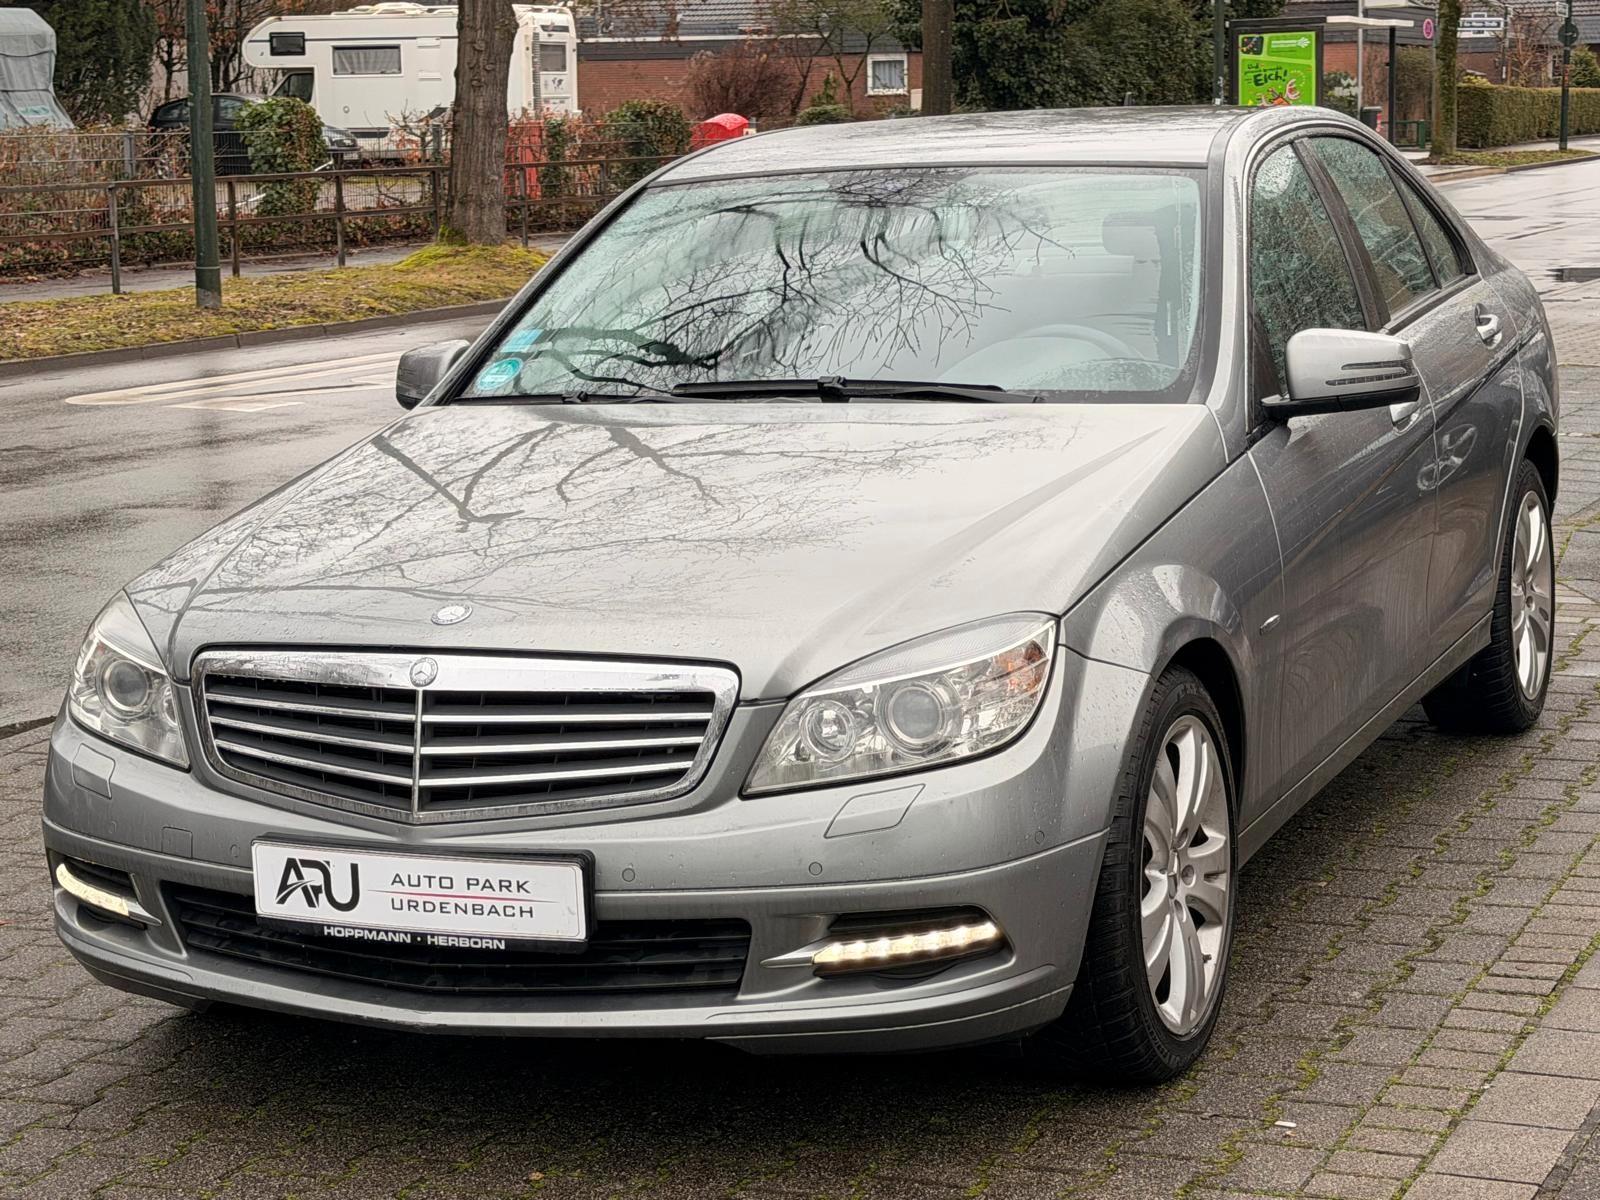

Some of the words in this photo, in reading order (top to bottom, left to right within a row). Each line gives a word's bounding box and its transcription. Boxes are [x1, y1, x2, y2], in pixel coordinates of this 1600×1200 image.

[391, 872, 454, 890] AUTO
[466, 877, 531, 894] PARK
[391, 897, 534, 919] URDENBACH
[323, 925, 411, 944] HOPPMANN
[427, 935, 506, 950] HERBORN
